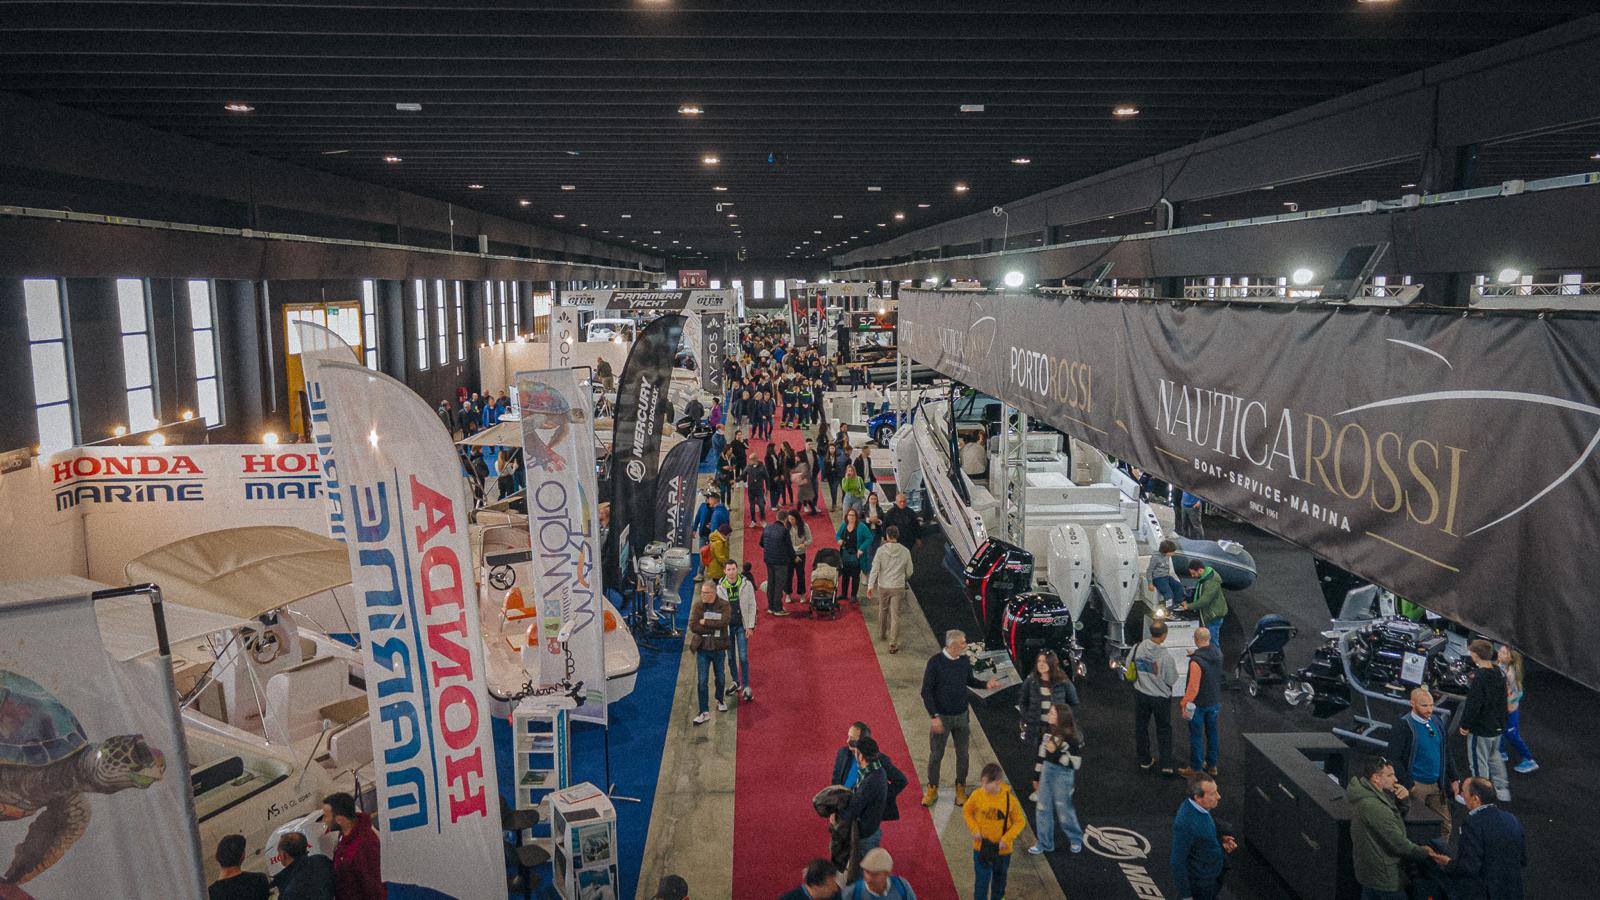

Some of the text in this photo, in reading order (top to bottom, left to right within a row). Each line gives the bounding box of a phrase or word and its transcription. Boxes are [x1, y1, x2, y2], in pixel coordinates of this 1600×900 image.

[613, 292, 683, 302] PANAMERA
[629, 300, 670, 308] YACHT
[707, 332, 719, 387] AYROS
[1010, 346, 1093, 414] PORTOROSSI
[632, 375, 652, 458] MERCURY
[51, 455, 204, 484] HONDA
[1154, 378, 1468, 538] NAUTICAROSSI
[56, 484, 205, 512] MARINE
[1118, 862, 1167, 900] ME
